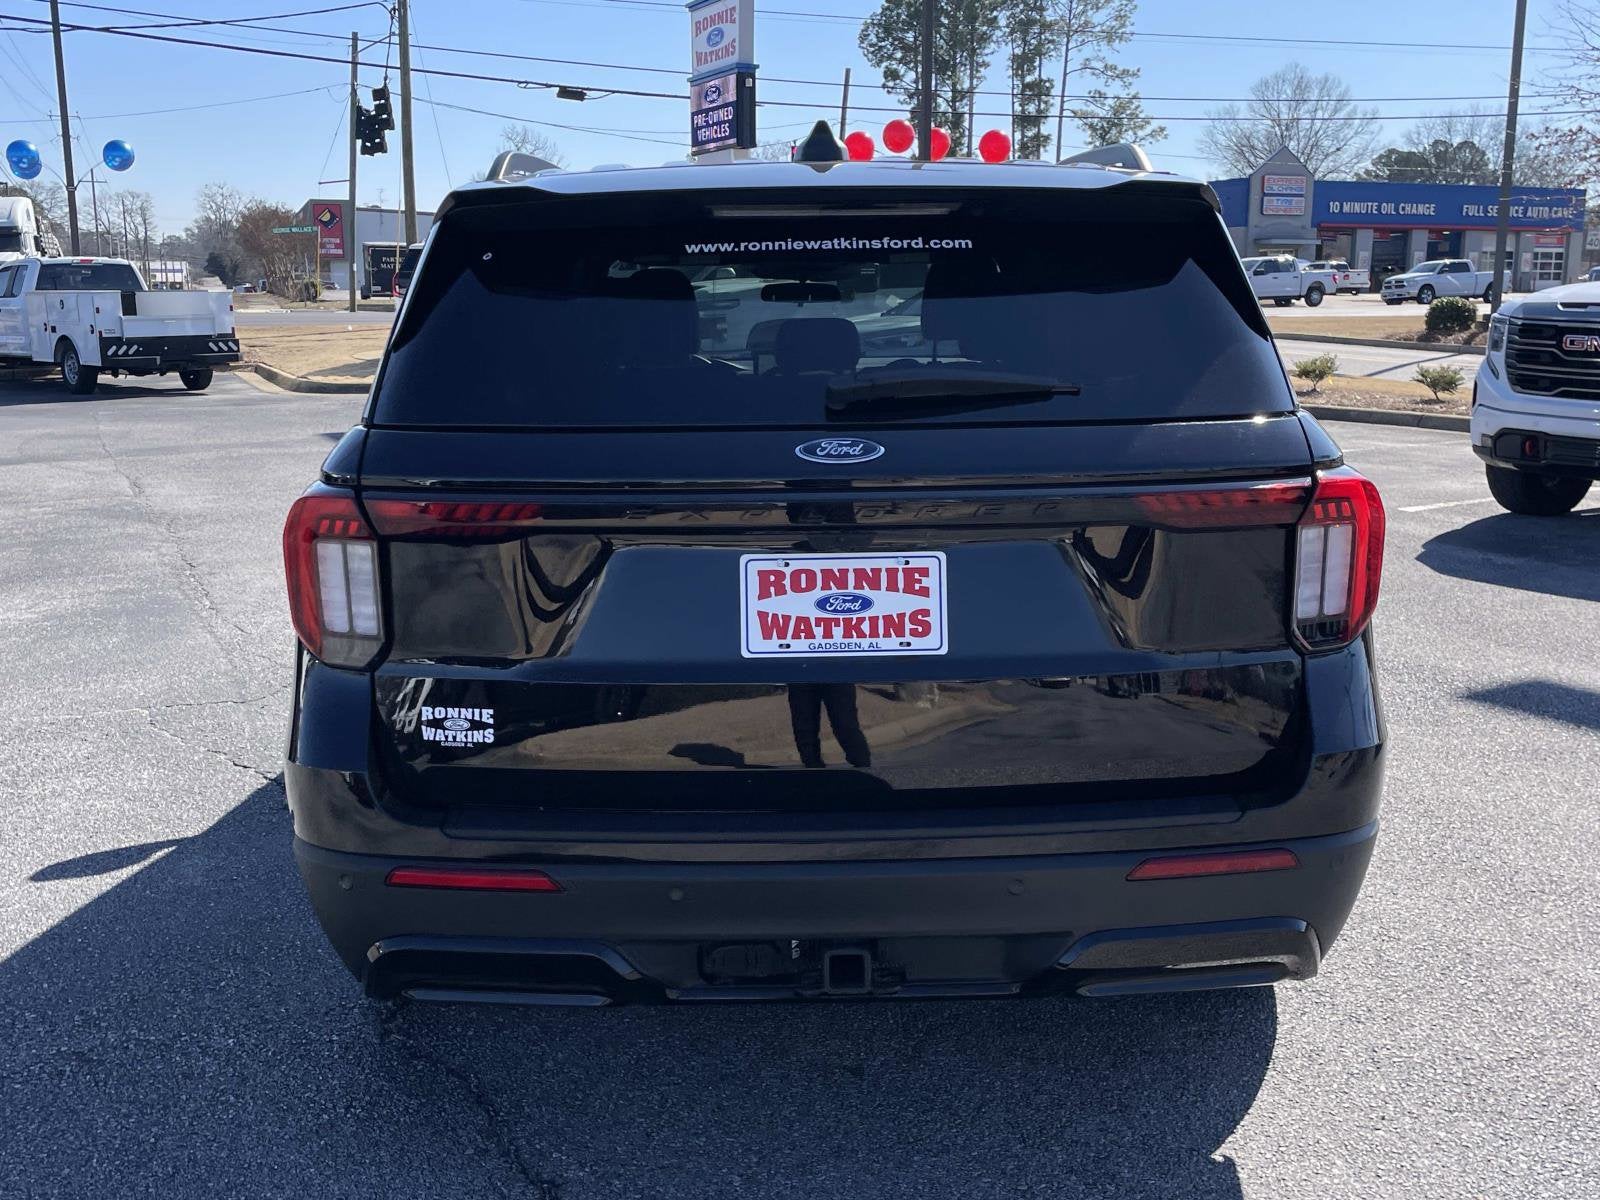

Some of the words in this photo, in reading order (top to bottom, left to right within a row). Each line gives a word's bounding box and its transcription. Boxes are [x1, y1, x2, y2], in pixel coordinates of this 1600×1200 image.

[695, 6, 736, 37] RONNIE
[696, 38, 736, 67] WATKINS
[693, 106, 733, 127] PRE-OWNED
[698, 123, 730, 141] VEHICLES
[1329, 202, 1340, 213] 10
[1343, 202, 1378, 214] MINUTE
[1380, 203, 1396, 215] OIL
[1399, 203, 1436, 216] CHANGE
[1462, 205, 1484, 216] FULL
[1487, 205, 1524, 218] SEICE
[1526, 206, 1548, 218] AUTO
[685, 237, 973, 253] www.ronniewatkinsford.com
[816, 440, 864, 456] Ford
[757, 567, 930, 600] RONNIE
[826, 595, 862, 611] Ford
[757, 608, 932, 640] WATKINS
[808, 641, 865, 651] GADSDEN,
[868, 641, 882, 649] AL
[421, 706, 494, 724] RONNIE
[421, 725, 494, 743] WATKINS
